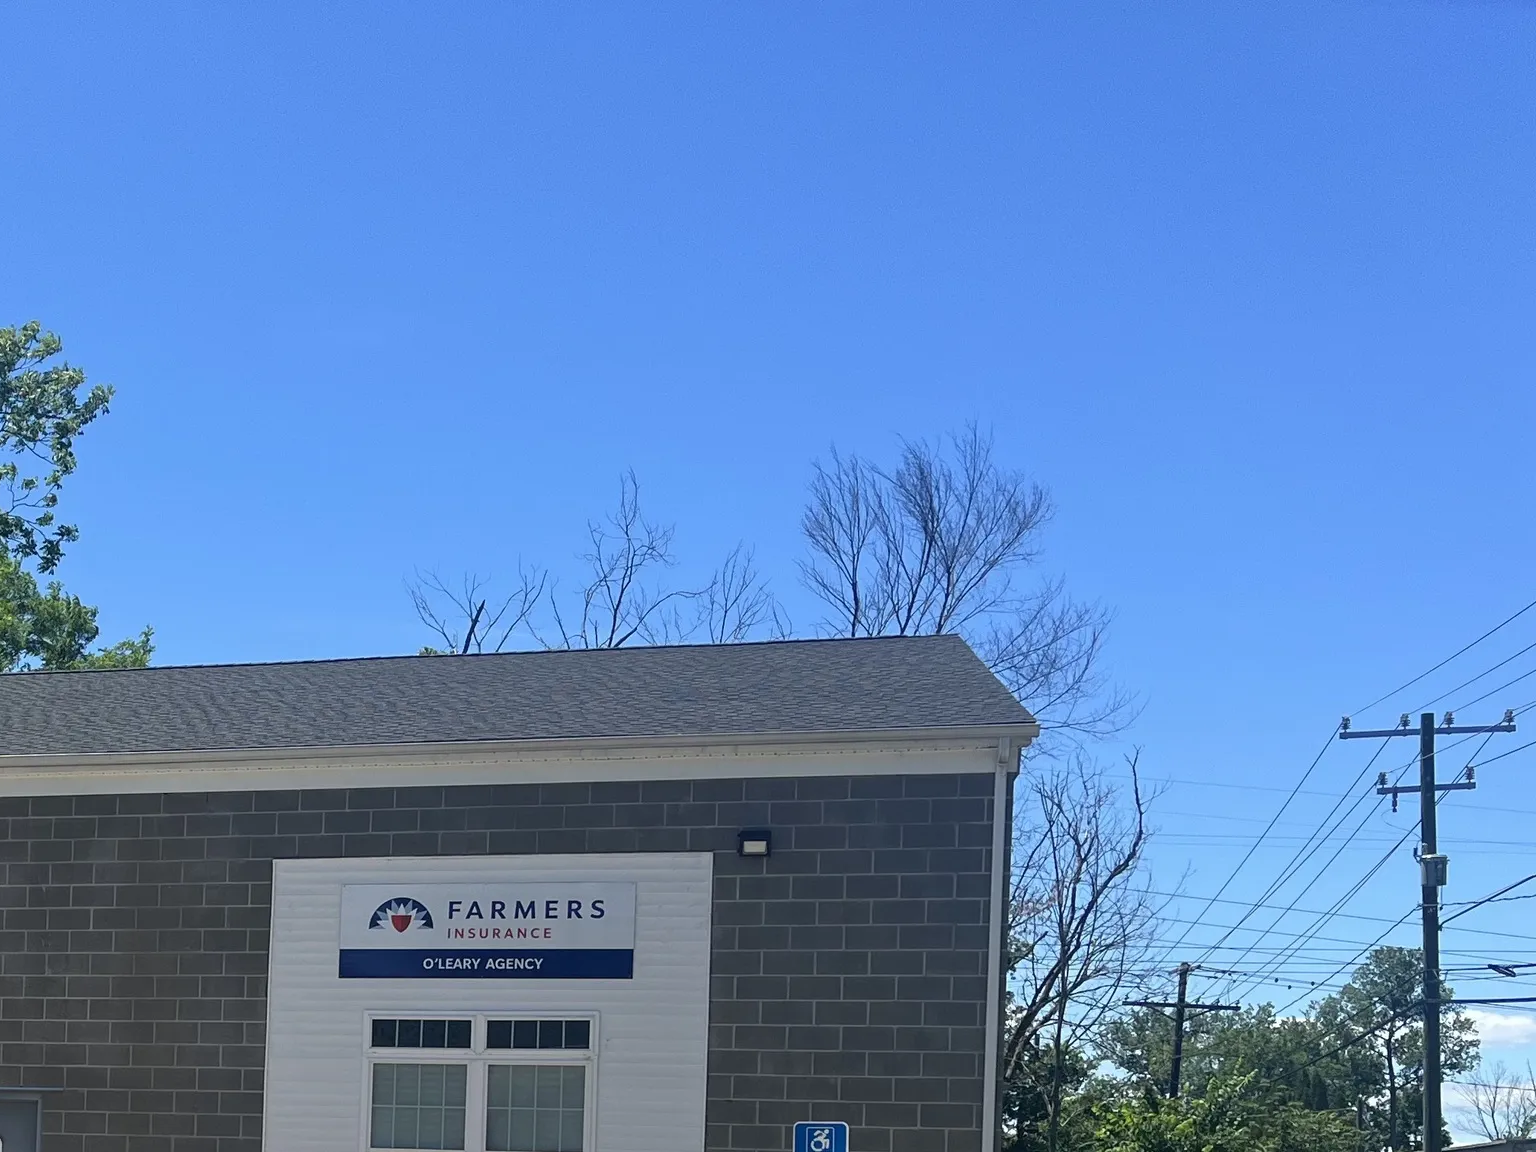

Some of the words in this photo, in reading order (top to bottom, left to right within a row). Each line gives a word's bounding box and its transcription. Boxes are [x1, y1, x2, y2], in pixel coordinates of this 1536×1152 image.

[447, 899, 606, 920] FARMERS
[447, 927, 552, 939] INSURANCE
[422, 957, 481, 970] O'LEARY
[485, 957, 543, 970] AGENCY
